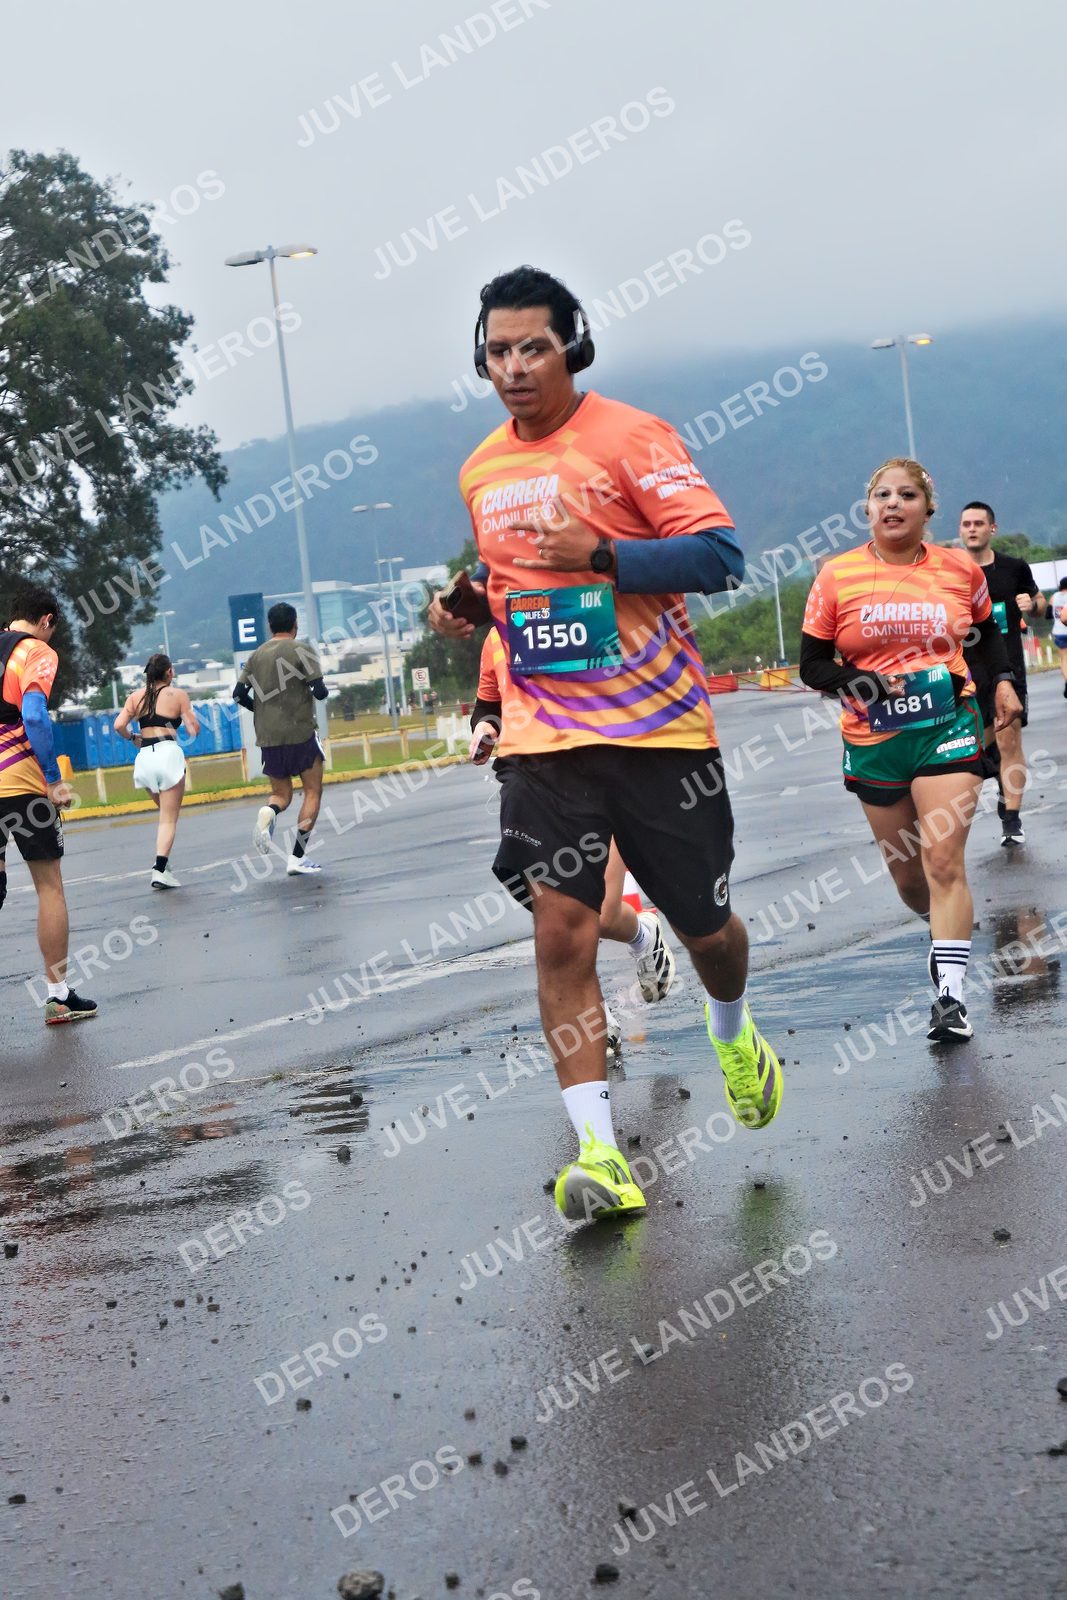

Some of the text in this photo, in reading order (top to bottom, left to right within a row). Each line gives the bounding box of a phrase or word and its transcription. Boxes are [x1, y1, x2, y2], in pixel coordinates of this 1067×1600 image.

[482, 474, 559, 516] CARRERA
[510, 596, 550, 611] CARRERA
[579, 591, 602, 609] 10K
[511, 610, 541, 621] ONILIFE
[860, 602, 947, 623] CARRERA
[238, 617, 257, 643] E
[523, 622, 588, 650] 1550
[862, 623, 929, 638] OMNILIFE
[927, 667, 944, 683] 10K
[882, 692, 933, 716] 1681
